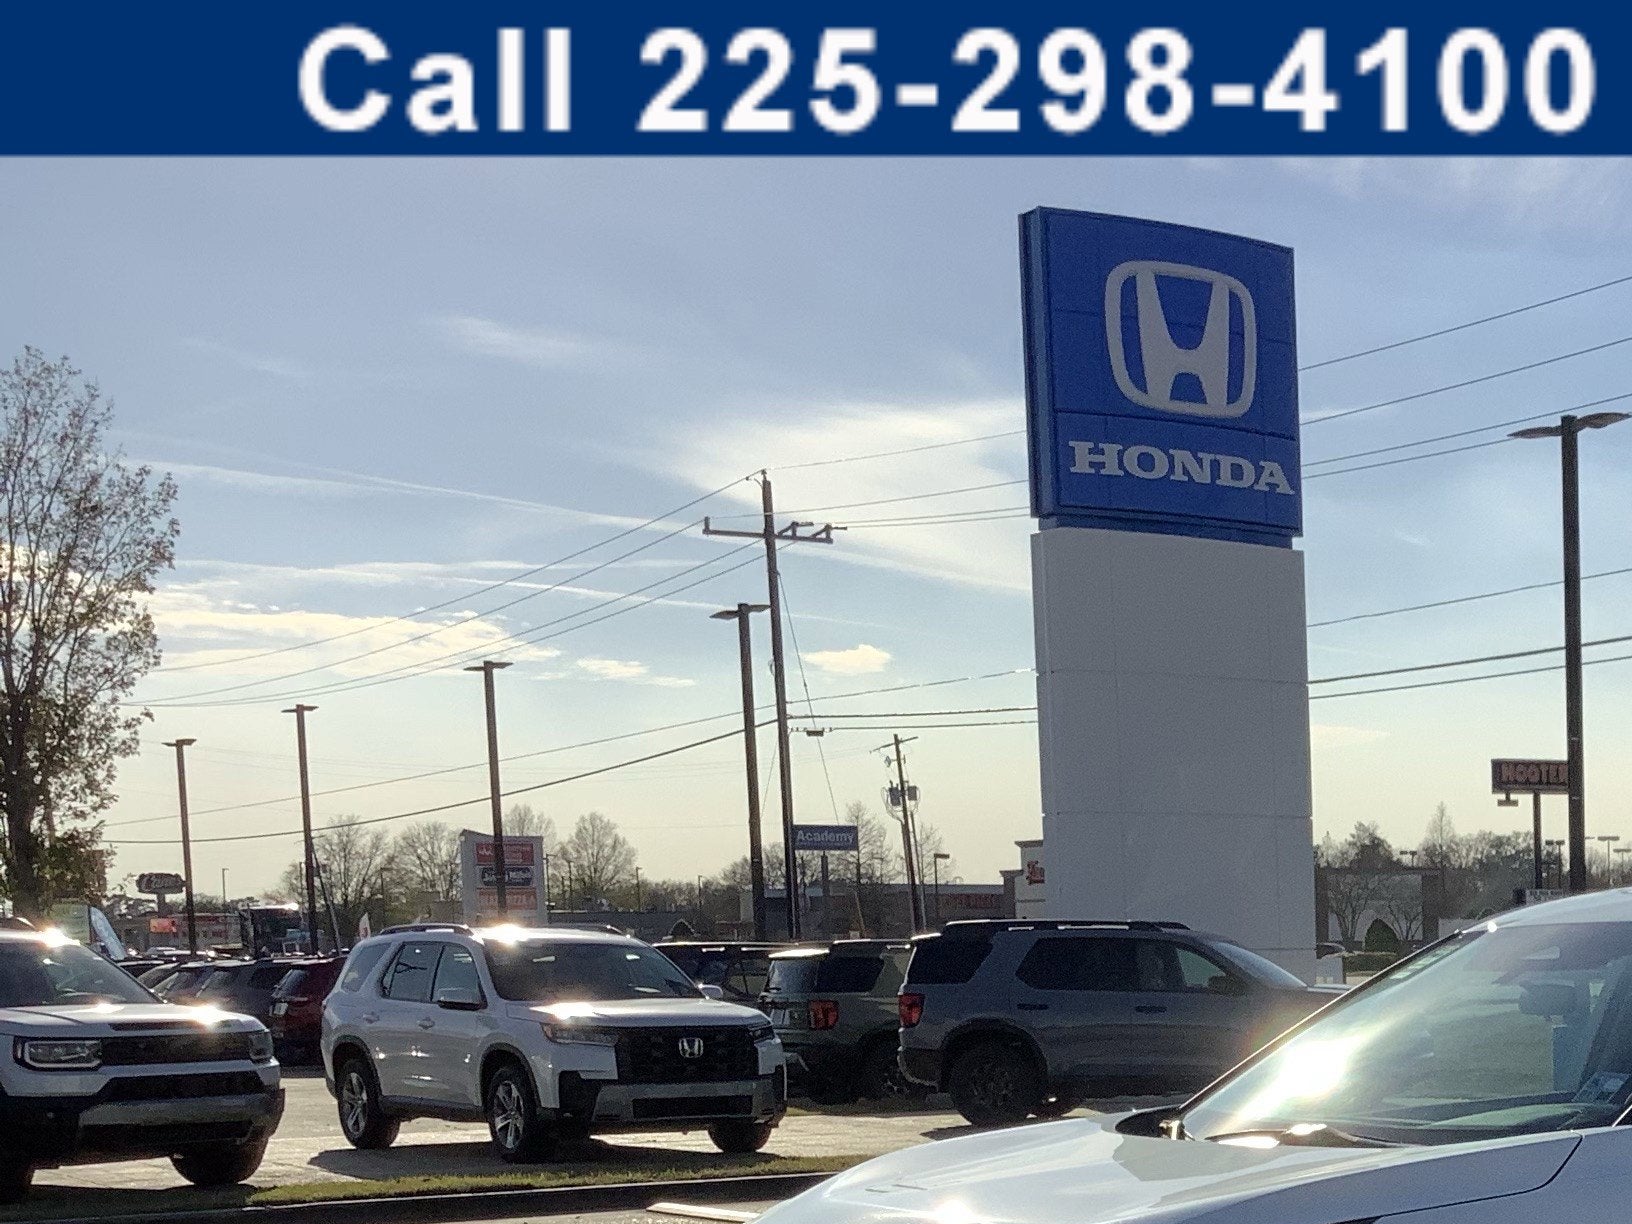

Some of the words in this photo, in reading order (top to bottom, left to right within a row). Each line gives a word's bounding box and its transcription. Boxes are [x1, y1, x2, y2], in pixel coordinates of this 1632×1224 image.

[1068, 440, 1295, 495] HONDA
[1502, 763, 1568, 784] HOOTER
[796, 829, 856, 845] Academy
